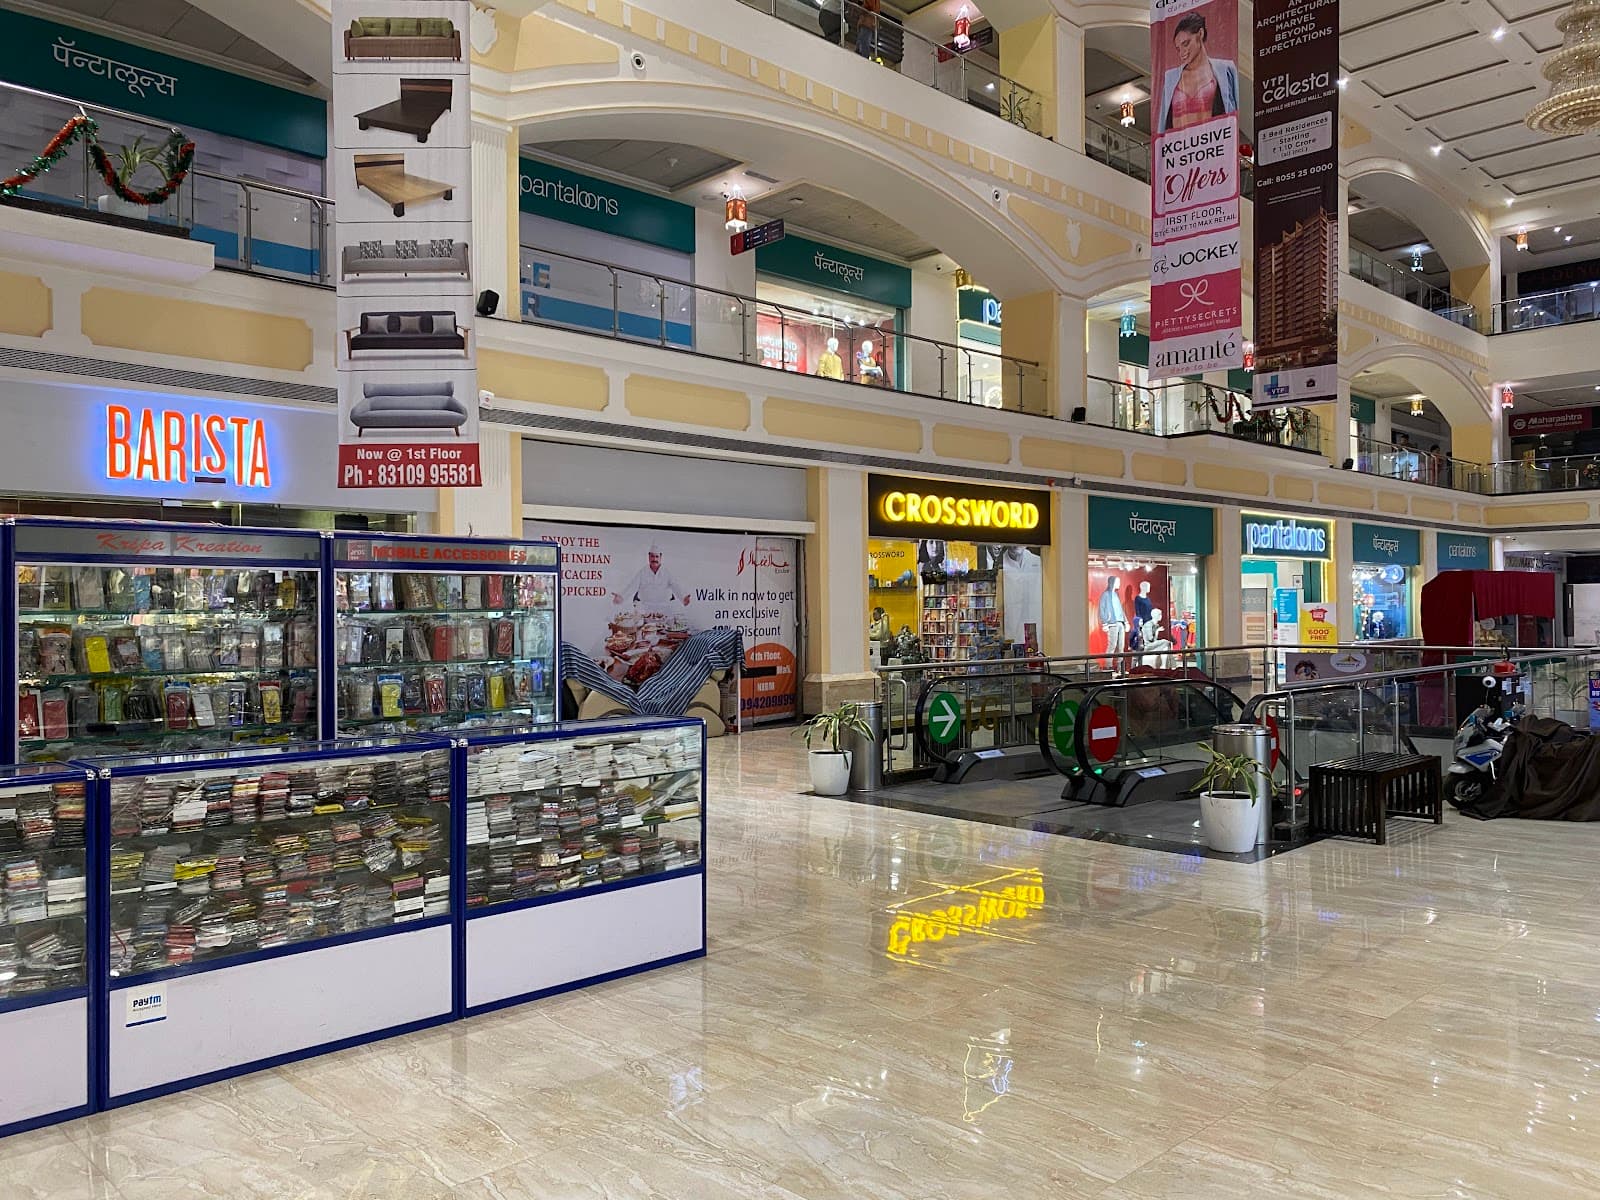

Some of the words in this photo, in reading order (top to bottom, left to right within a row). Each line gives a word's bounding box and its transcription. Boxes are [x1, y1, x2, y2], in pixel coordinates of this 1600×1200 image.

[1275, 13, 1316, 32] MARVEL
[1259, 26, 1333, 57] EXPECTATIONS
[1274, 23, 1316, 42] BEYOND
[52, 36, 178, 98] पॅन्टालून्स
[1262, 75, 1285, 89] VTP
[1262, 71, 1329, 104] celesta
[1285, 116, 1328, 133] Residences
[1279, 132, 1309, 145] Starting
[1295, 138, 1316, 148] Crore
[1179, 144, 1225, 166] STORE
[1257, 178, 1274, 187] Call:
[1276, 171, 1296, 183] 8055
[1298, 168, 1308, 178] 25
[1309, 162, 1334, 174] 0000
[1164, 166, 1229, 205] Offers
[1155, 332, 1236, 368] amanté
[106, 404, 271, 488] BARISTA
[356, 448, 383, 460] Now
[387, 448, 402, 462] @
[406, 448, 426, 459] 1st
[430, 447, 462, 459] Floor
[344, 464, 363, 486] Ph
[378, 464, 425, 485] 83109
[429, 463, 476, 485] 95581
[885, 491, 1039, 529] CROSSWORD
[96, 533, 166, 554] Kripa
[174, 535, 263, 554] Kreation
[578, 538, 599, 548] THE
[1246, 519, 1325, 554] pantaloons
[372, 545, 428, 560] MOBILE
[431, 547, 528, 562] ACCESSORIES
[572, 553, 611, 564] INDIAN
[696, 588, 725, 601] Walk
[728, 589, 738, 601] in
[742, 592, 764, 601] now
[767, 591, 776, 601] to
[778, 590, 794, 603] get
[715, 610, 729, 619] an
[732, 607, 779, 619] exclusive
[736, 625, 781, 637] Discount
